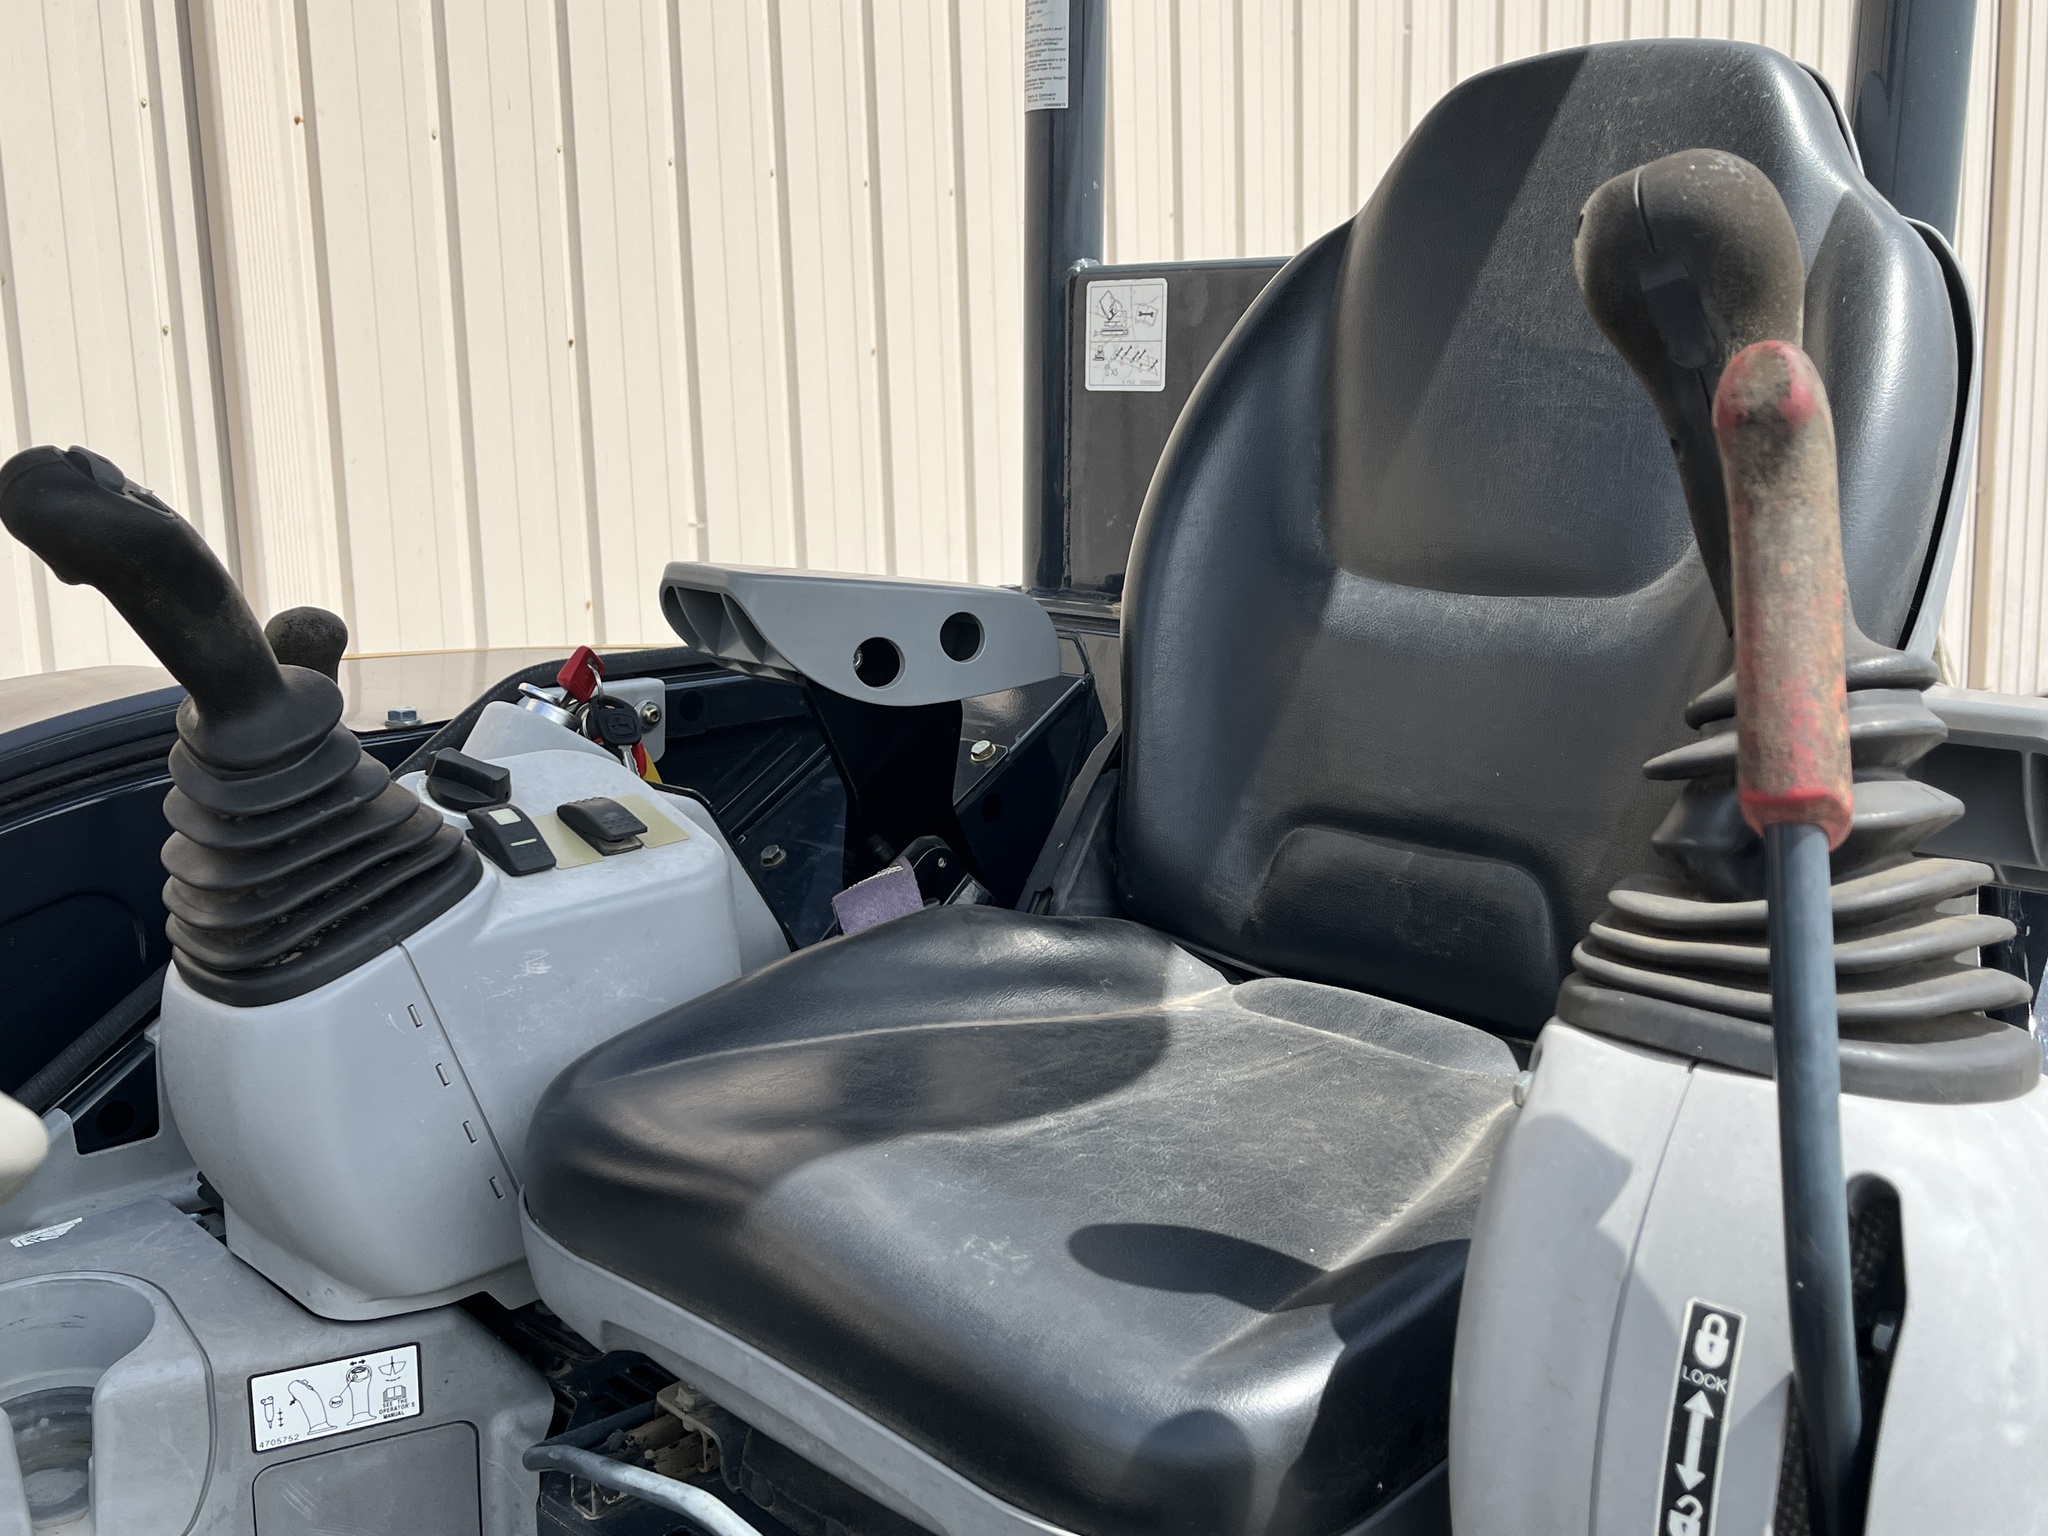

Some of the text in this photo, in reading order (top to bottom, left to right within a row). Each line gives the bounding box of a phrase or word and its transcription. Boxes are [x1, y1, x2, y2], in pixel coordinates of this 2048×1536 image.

[1682, 1365, 1728, 1394] LOCK
[379, 1401, 415, 1415] OPERATOR'S
[383, 1411, 405, 1419] MANUAL
[258, 1433, 300, 1449] 4705752
